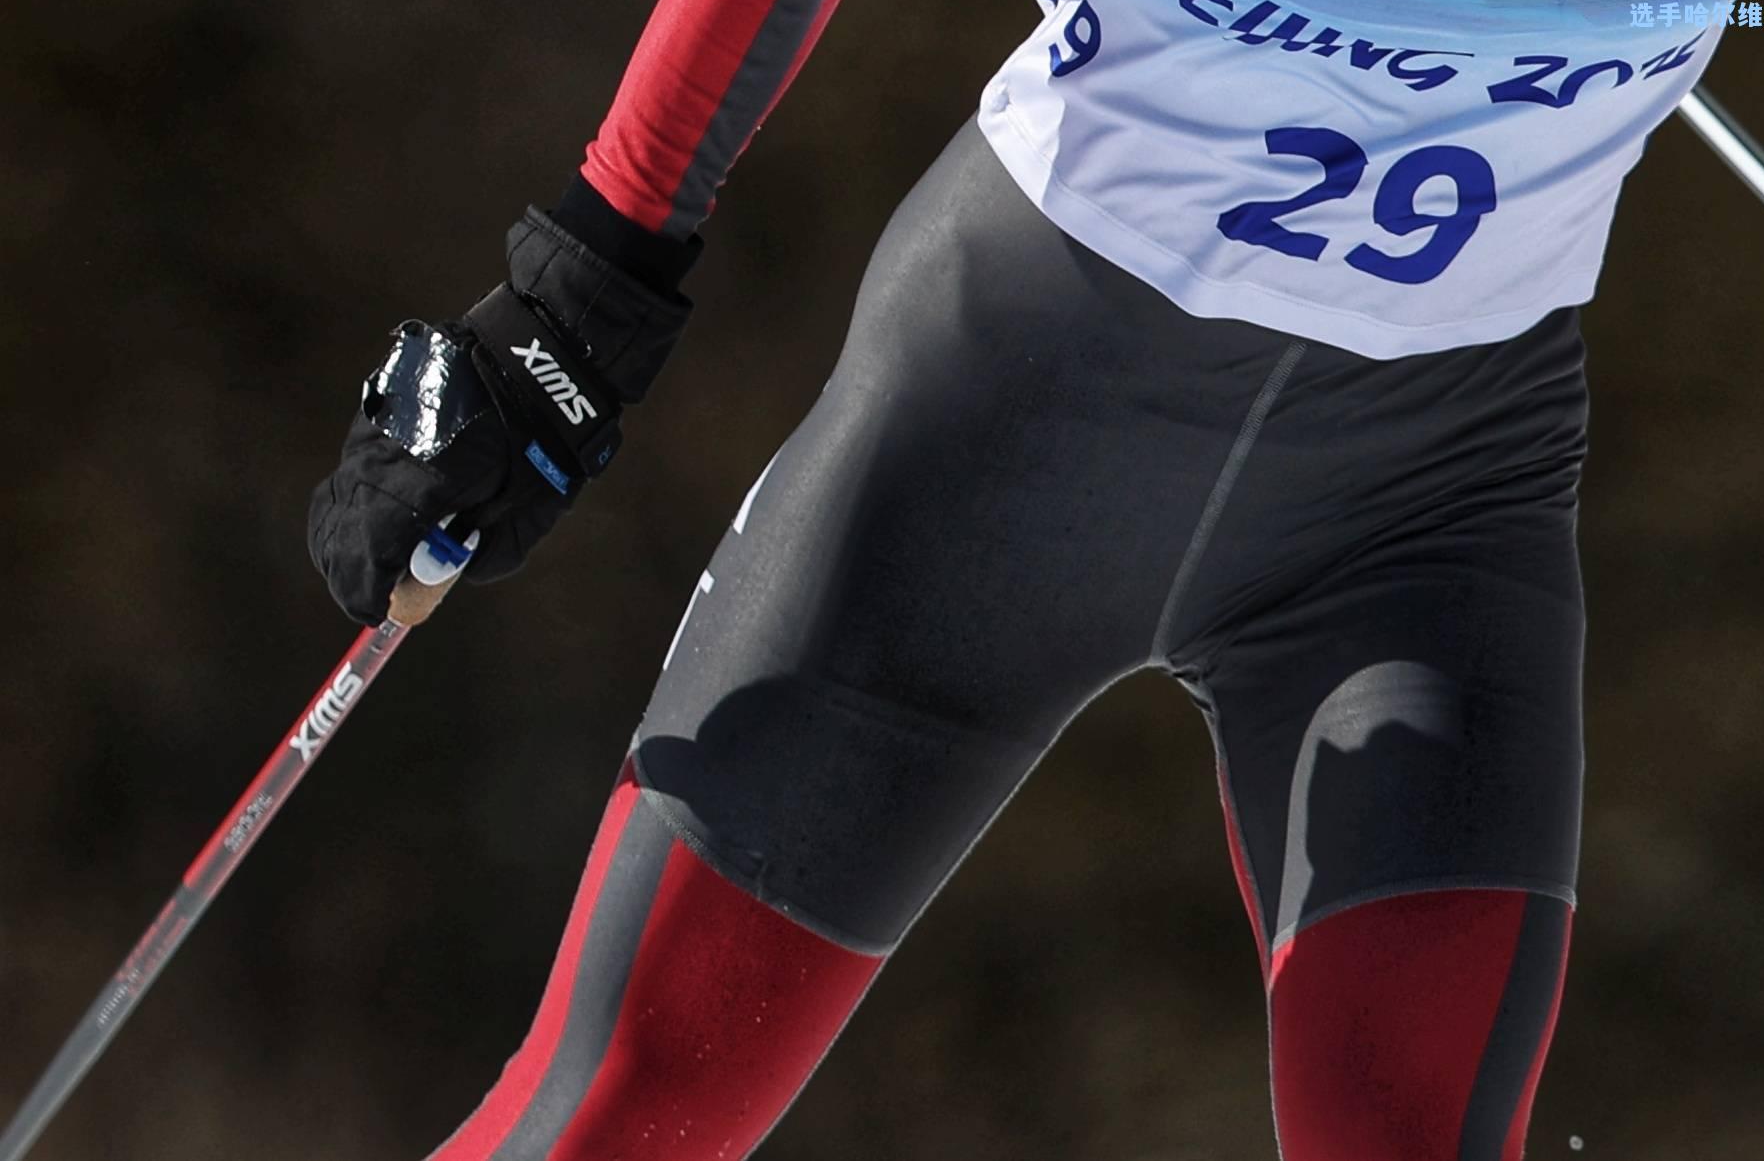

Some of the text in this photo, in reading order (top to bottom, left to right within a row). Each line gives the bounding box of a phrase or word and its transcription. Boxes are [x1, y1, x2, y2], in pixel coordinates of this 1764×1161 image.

[1217, 127, 1497, 285] 29
[510, 338, 597, 425] SWIX
[289, 661, 363, 761] SWIX
